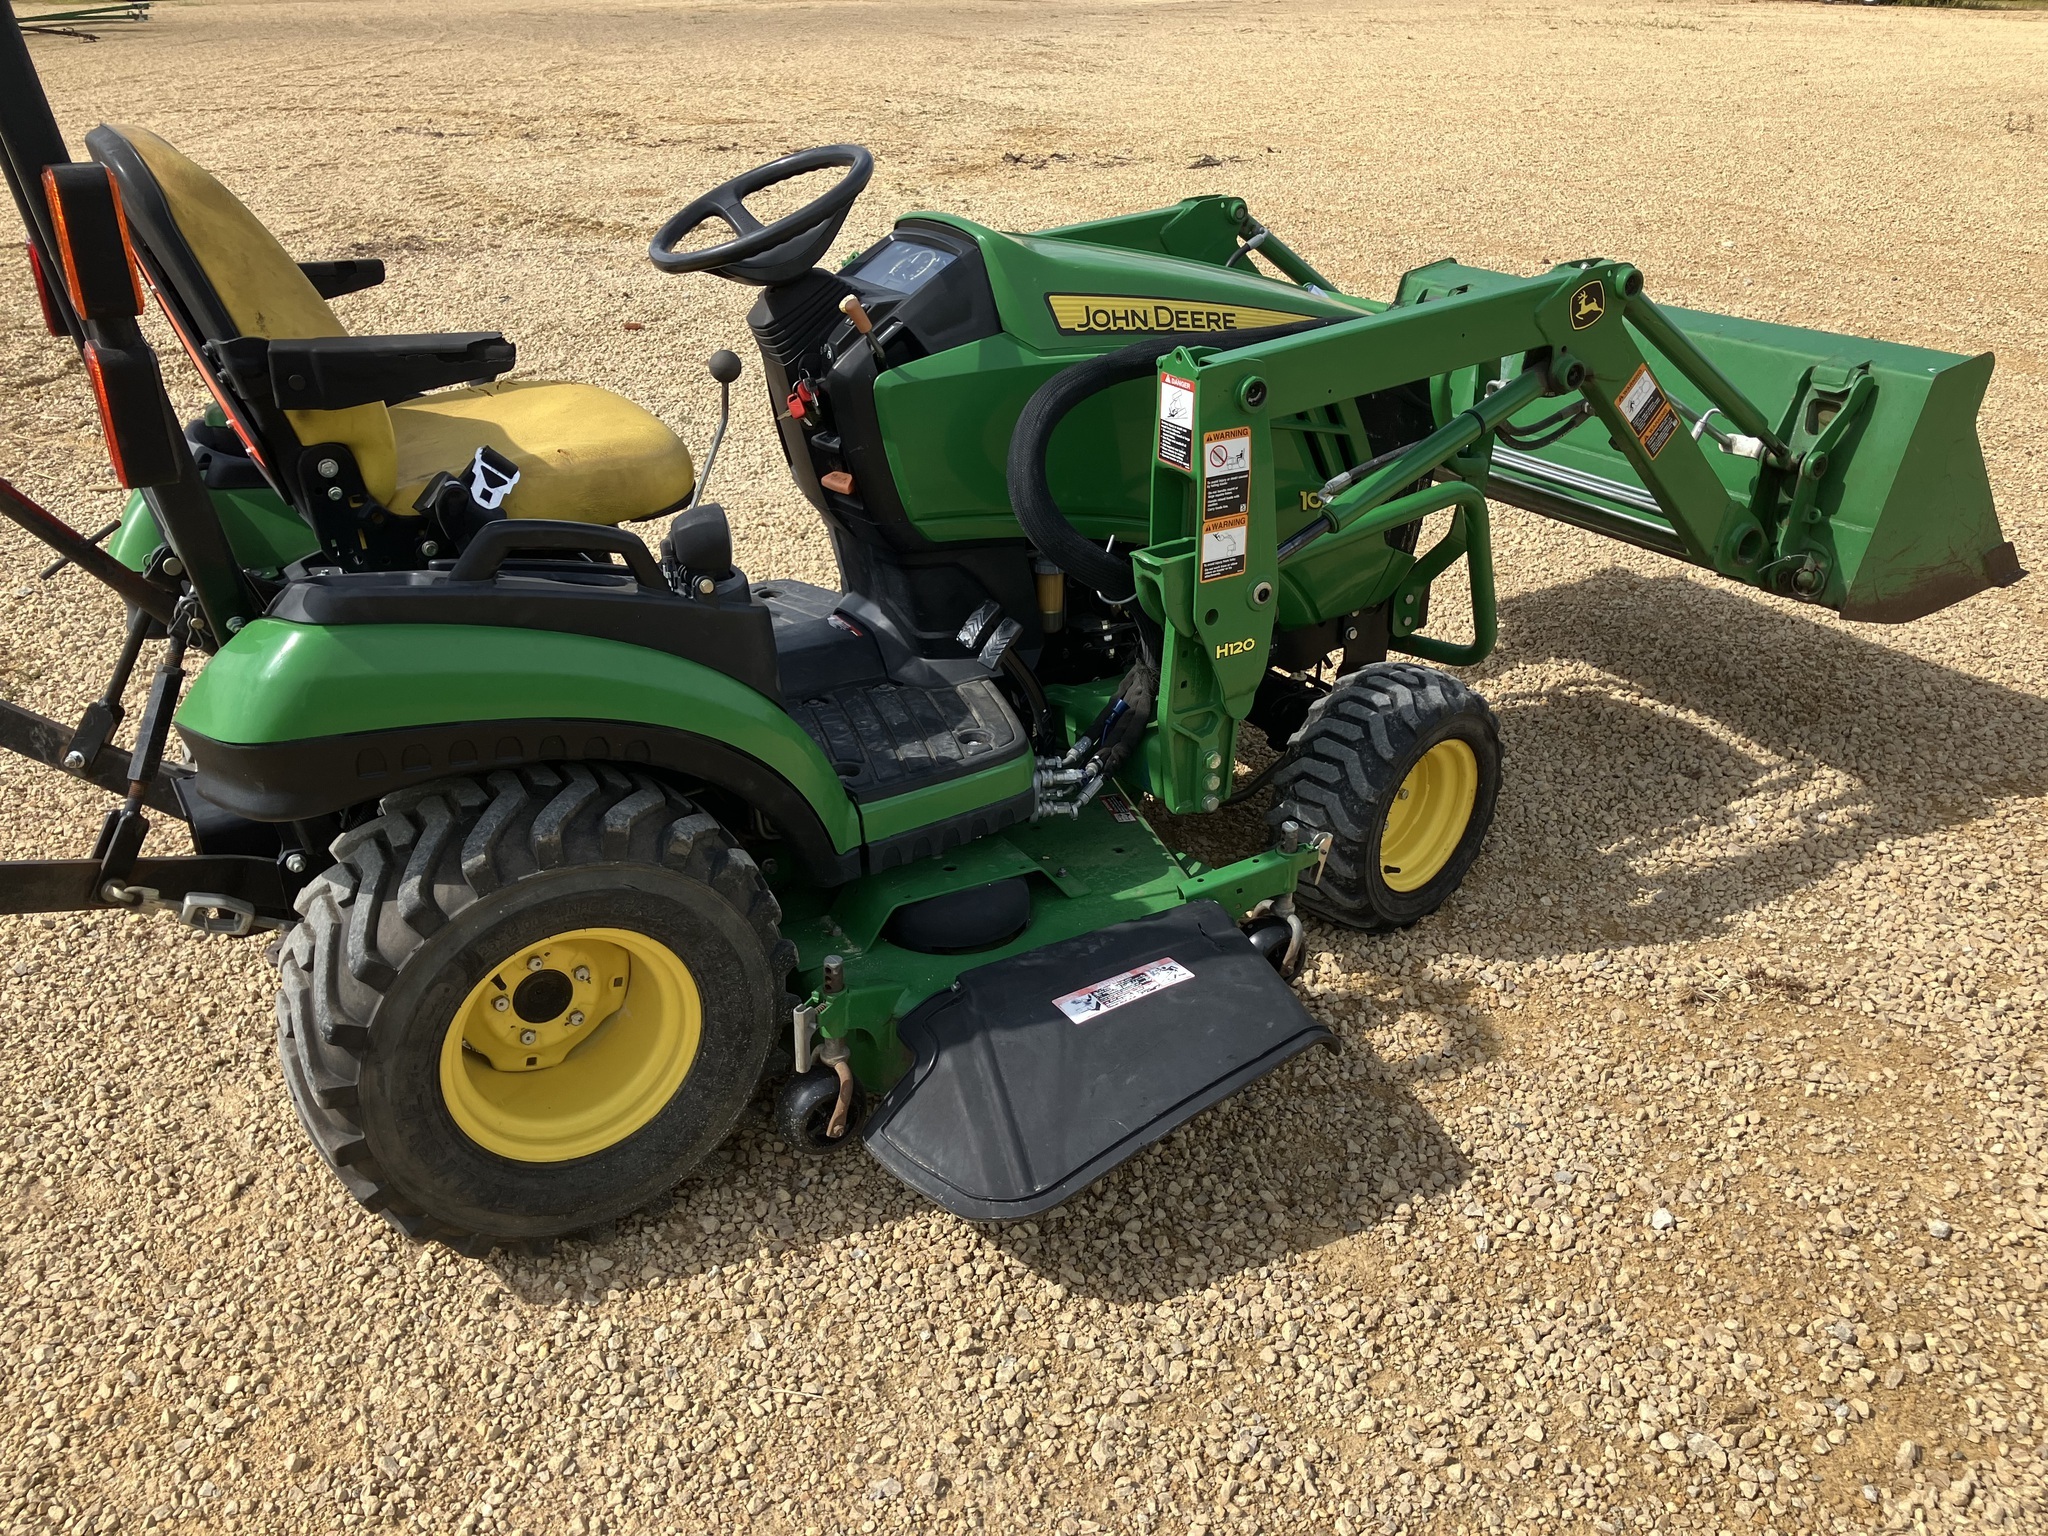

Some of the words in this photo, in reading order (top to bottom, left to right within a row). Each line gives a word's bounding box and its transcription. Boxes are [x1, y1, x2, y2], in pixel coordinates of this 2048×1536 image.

[1077, 305, 1149, 329] JOHN
[1153, 305, 1237, 330] DEERE
[1171, 377, 1190, 390] DANGER
[1212, 428, 1249, 441] WARNING
[1300, 491, 1322, 511] 10
[1211, 517, 1246, 531] WARNING
[1216, 637, 1255, 660] H120
